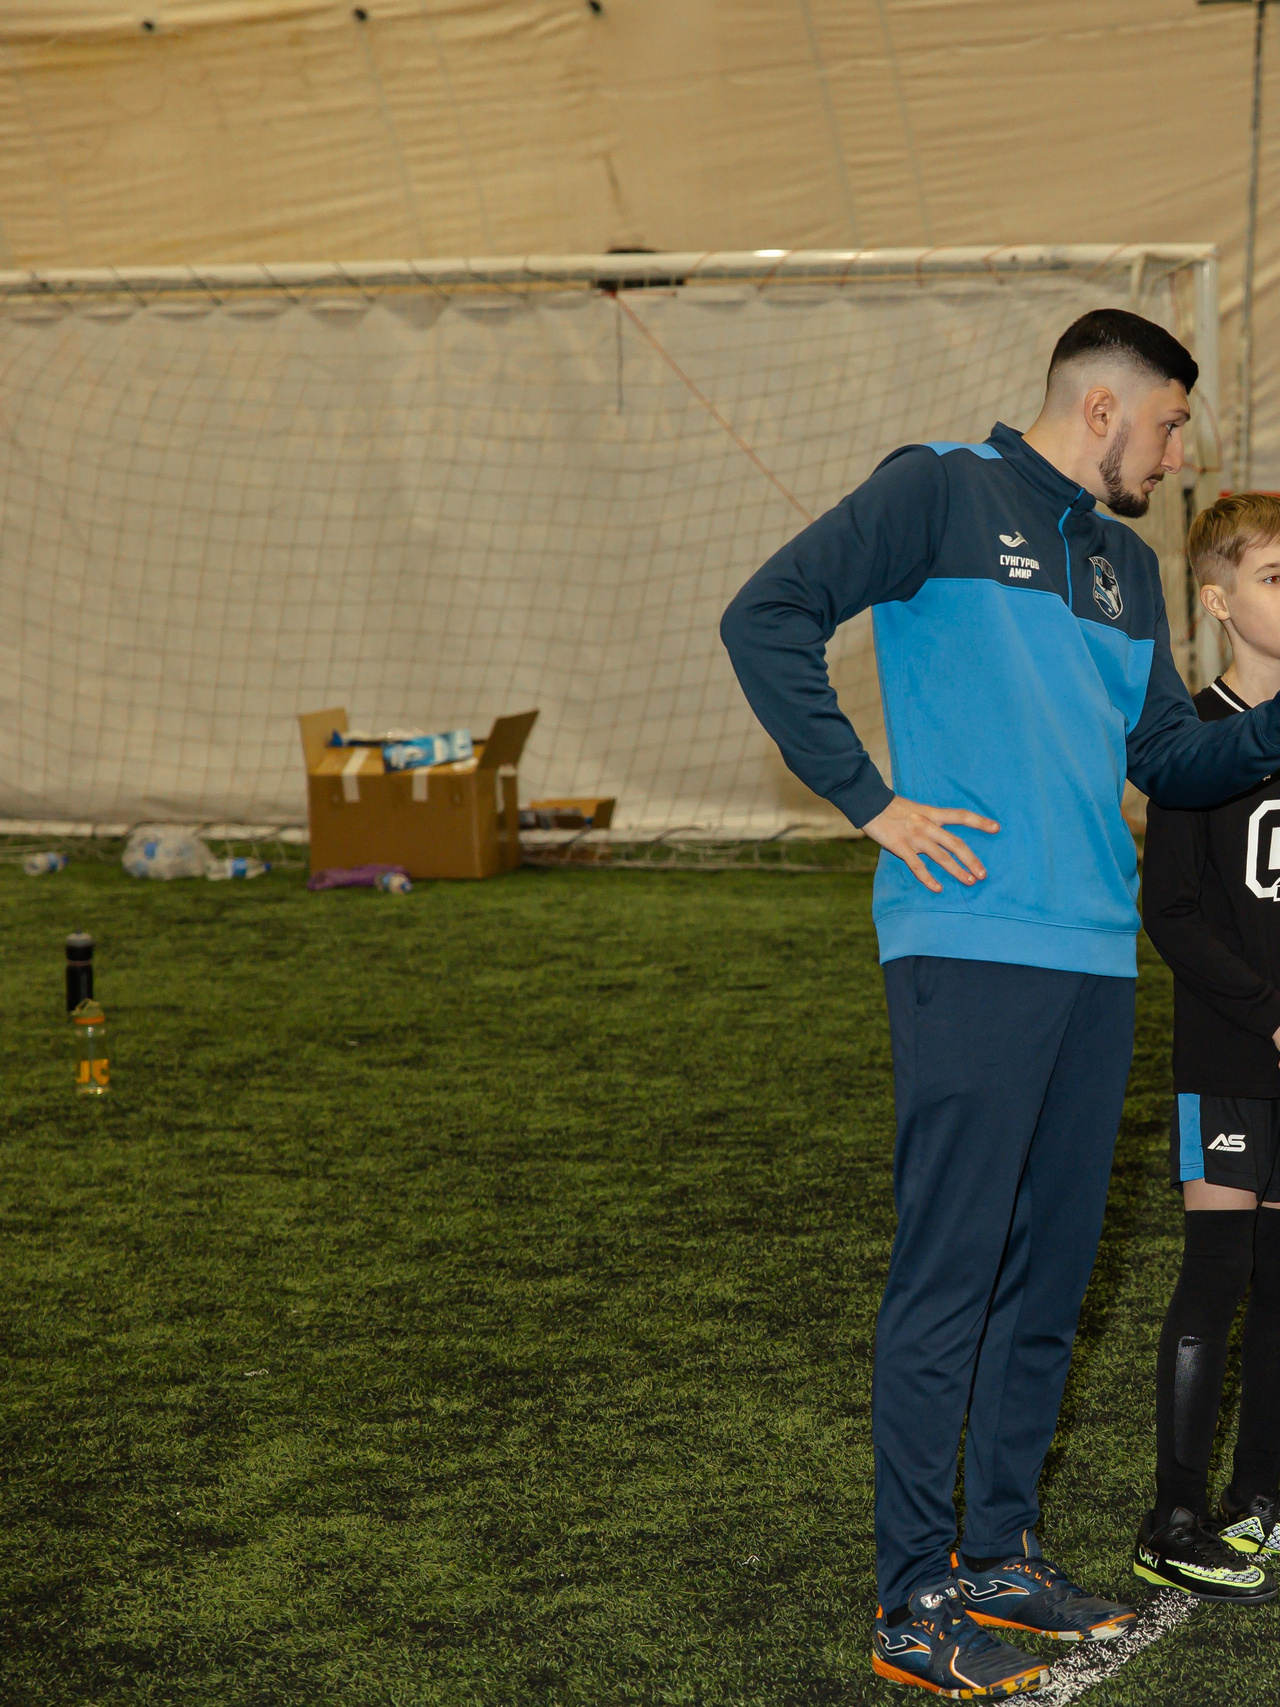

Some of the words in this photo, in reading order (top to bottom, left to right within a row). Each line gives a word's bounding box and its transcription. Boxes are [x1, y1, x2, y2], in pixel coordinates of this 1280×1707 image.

[1000, 554, 1040, 570] СУНГУРОВ
[1009, 567, 1032, 579] АМИР
[1207, 1133, 1246, 1152] AS
